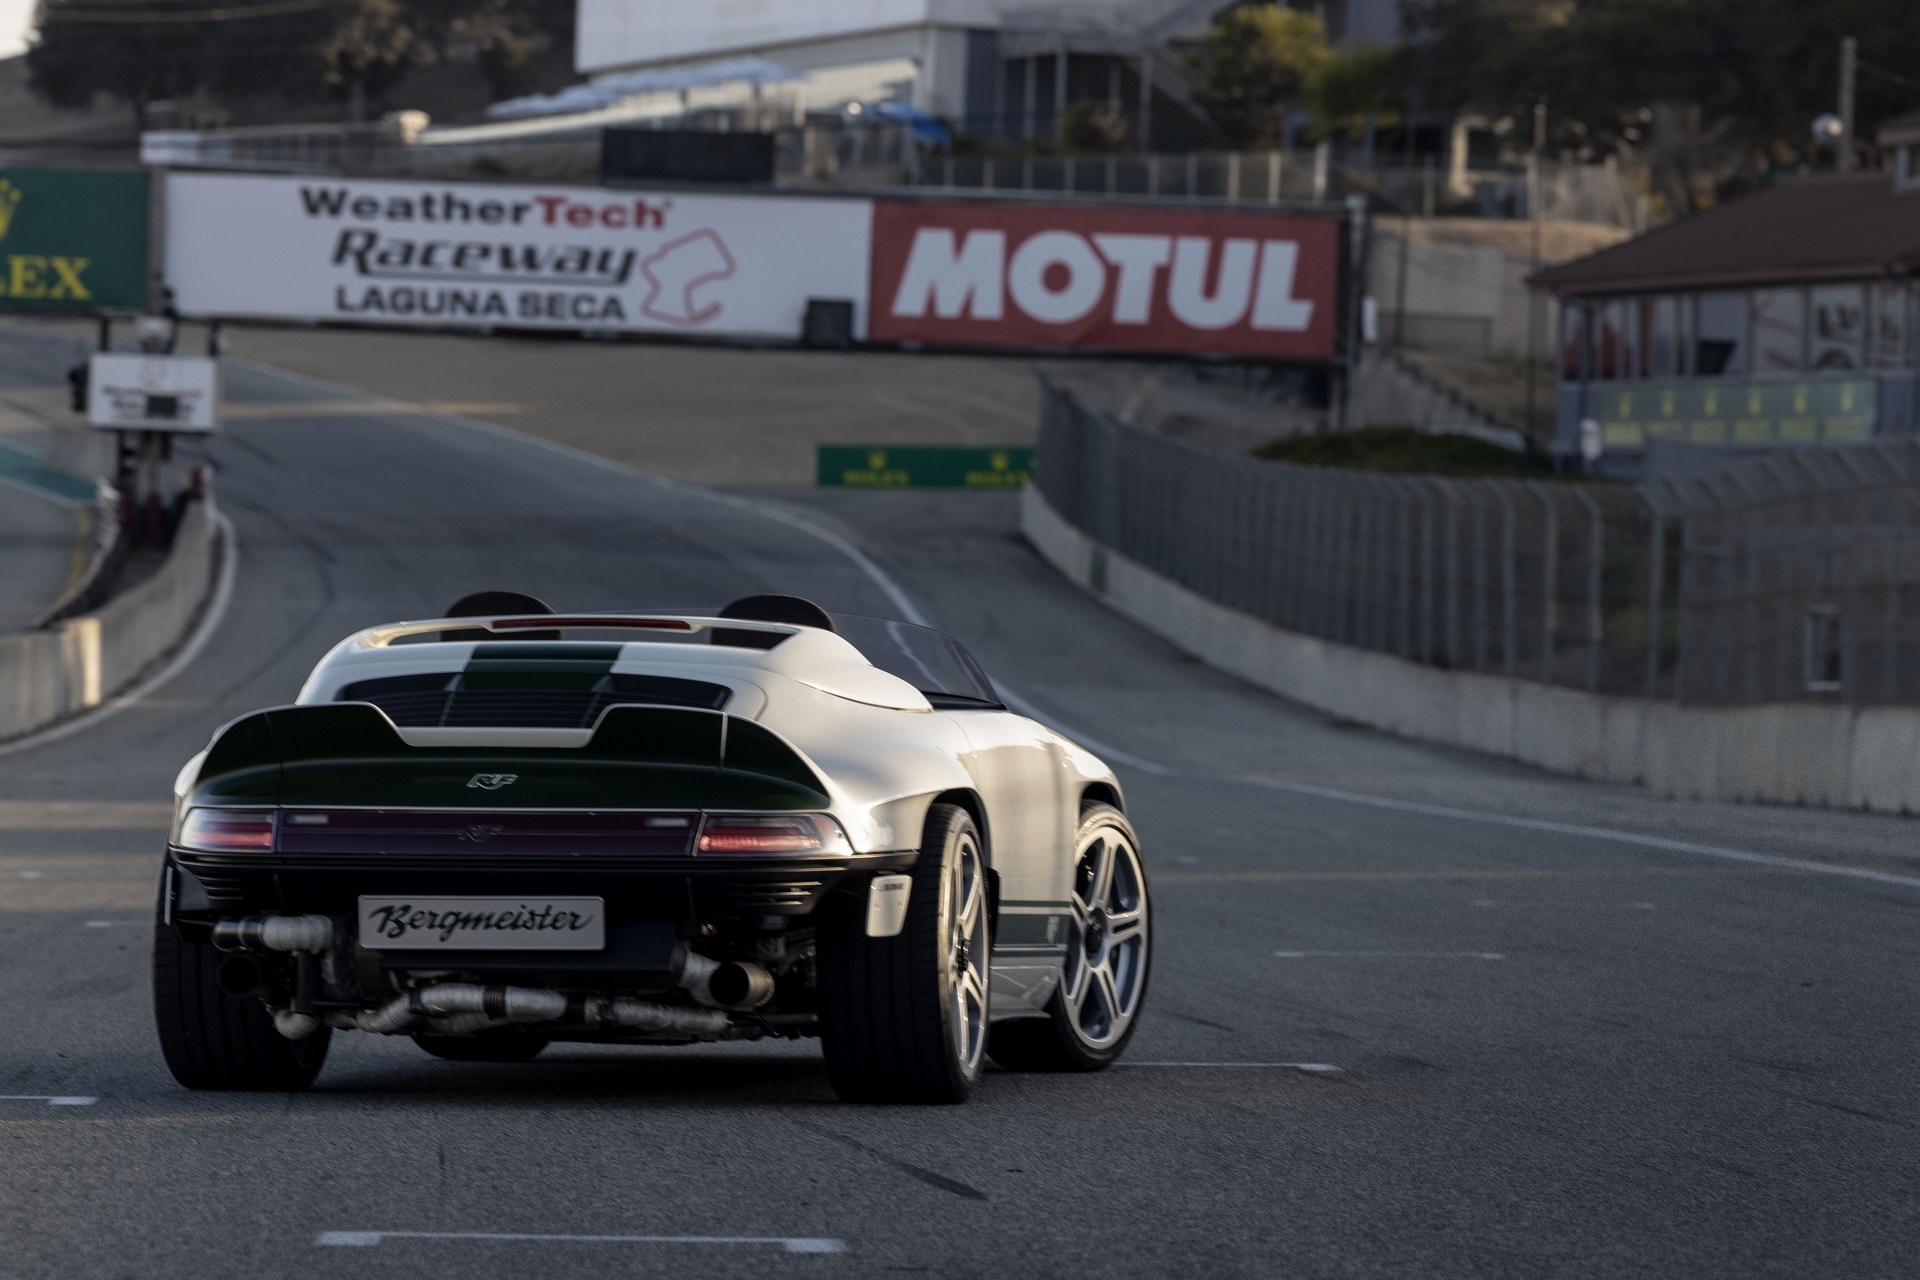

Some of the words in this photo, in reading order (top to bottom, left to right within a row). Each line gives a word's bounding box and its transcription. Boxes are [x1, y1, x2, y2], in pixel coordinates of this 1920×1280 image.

[0, 254, 92, 300] EX
[332, 227, 636, 286] Raceway
[891, 228, 1314, 331] MOTUL
[335, 284, 507, 318] LAGUNA
[517, 290, 626, 322] SECA
[368, 904, 595, 942] Bergmeister
